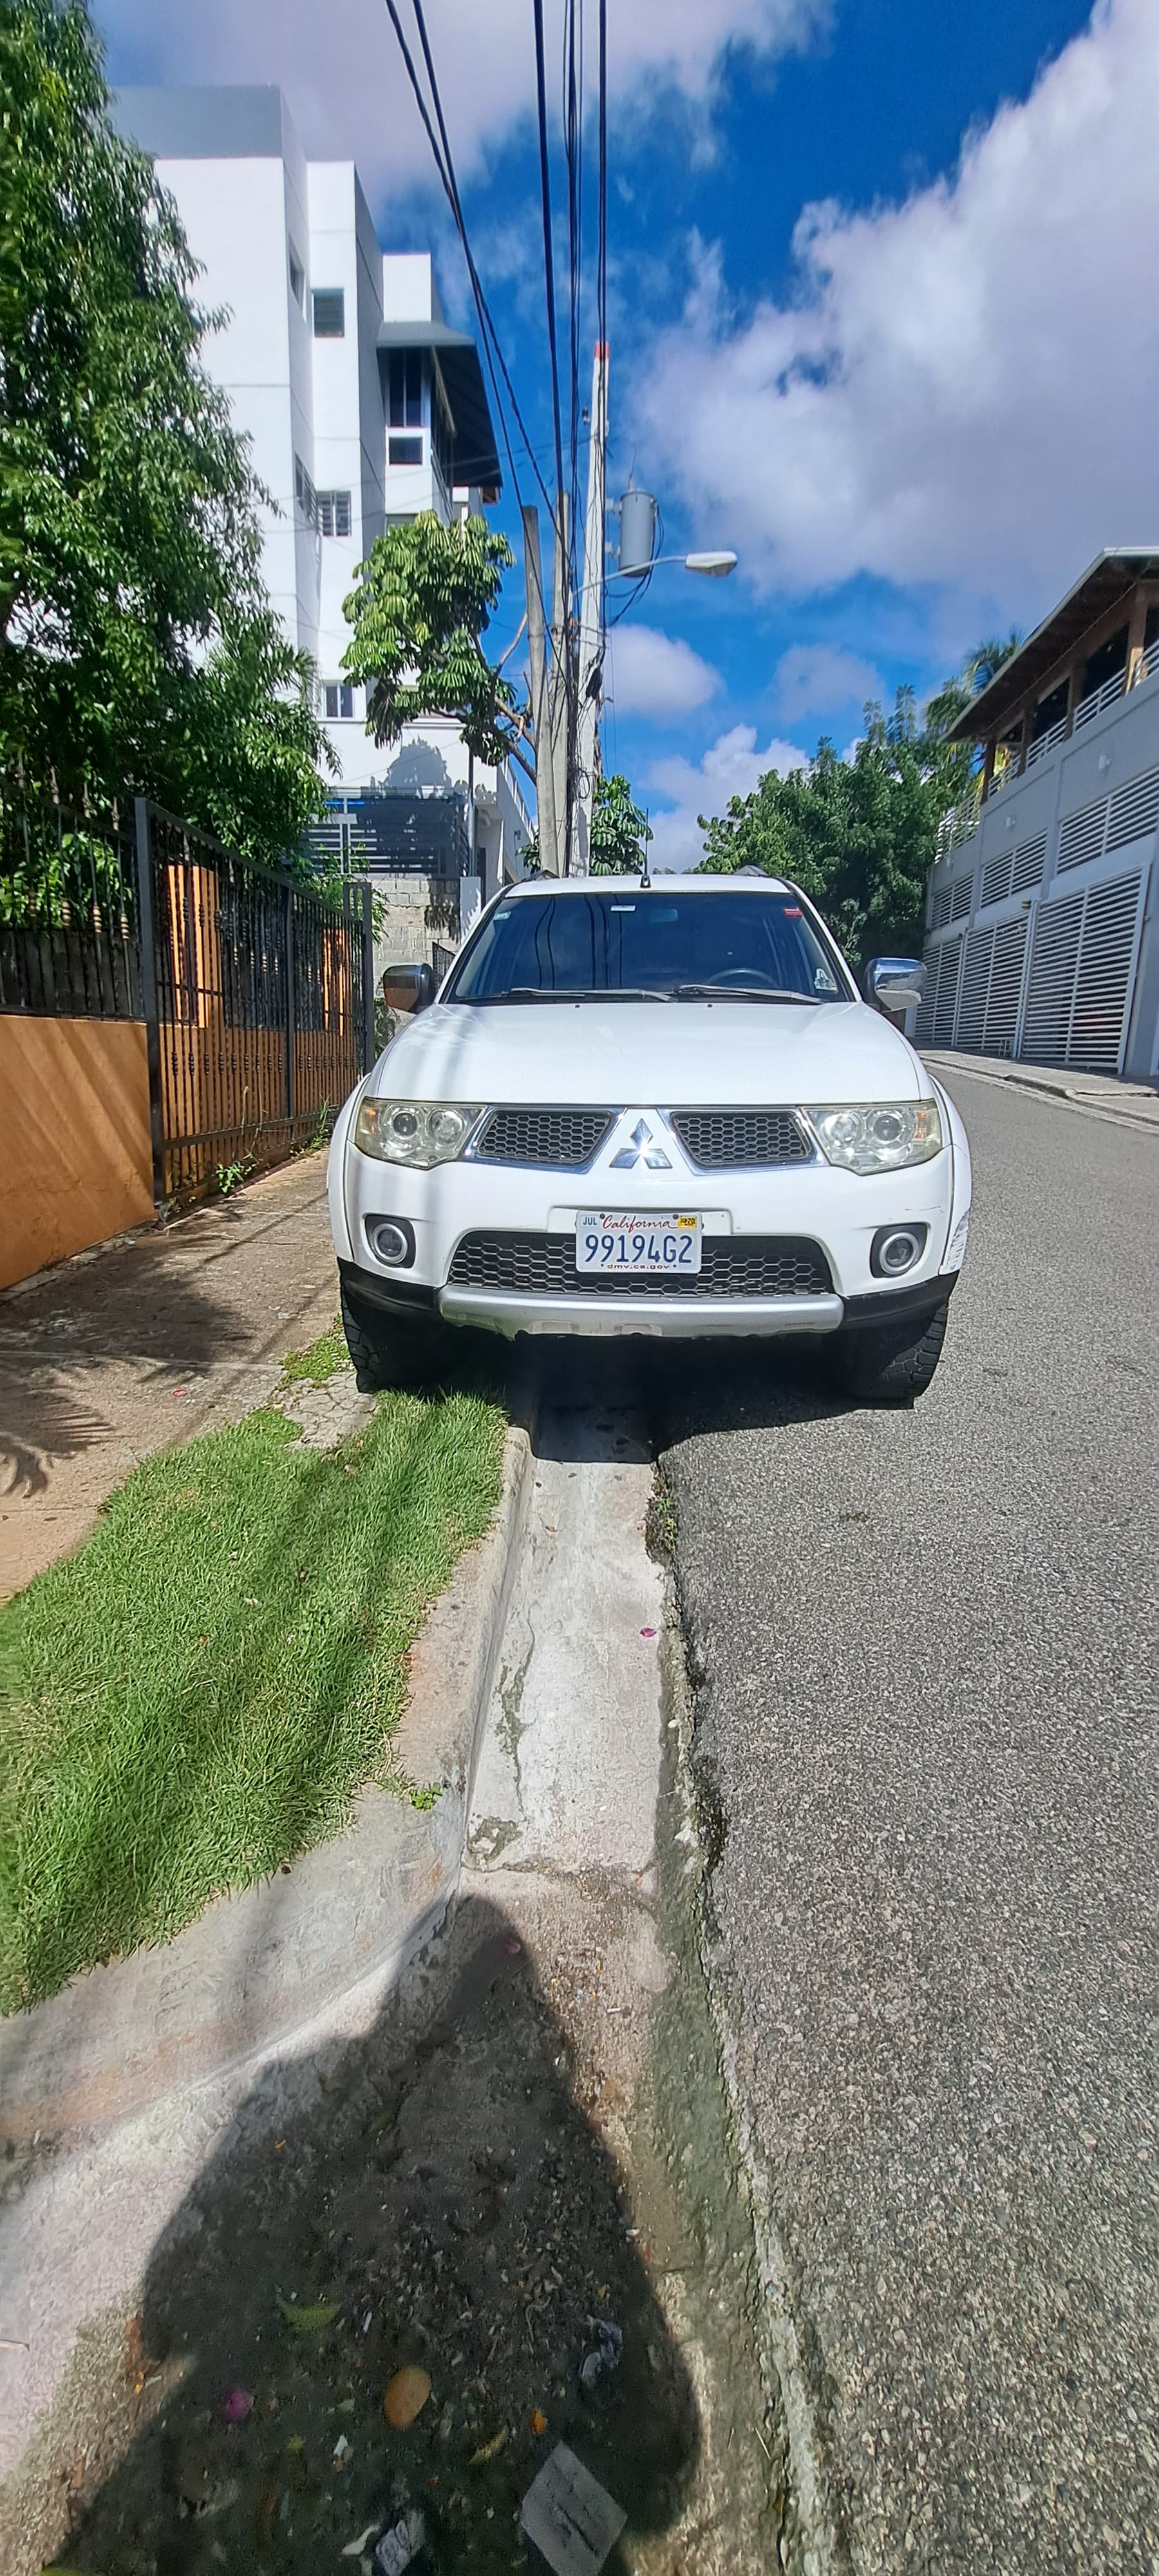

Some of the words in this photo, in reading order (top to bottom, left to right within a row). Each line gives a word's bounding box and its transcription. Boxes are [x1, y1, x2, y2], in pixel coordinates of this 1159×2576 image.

[583, 1217, 598, 1226] JUL
[603, 1215, 678, 1233] California
[585, 1235, 692, 1264] 99194G2
